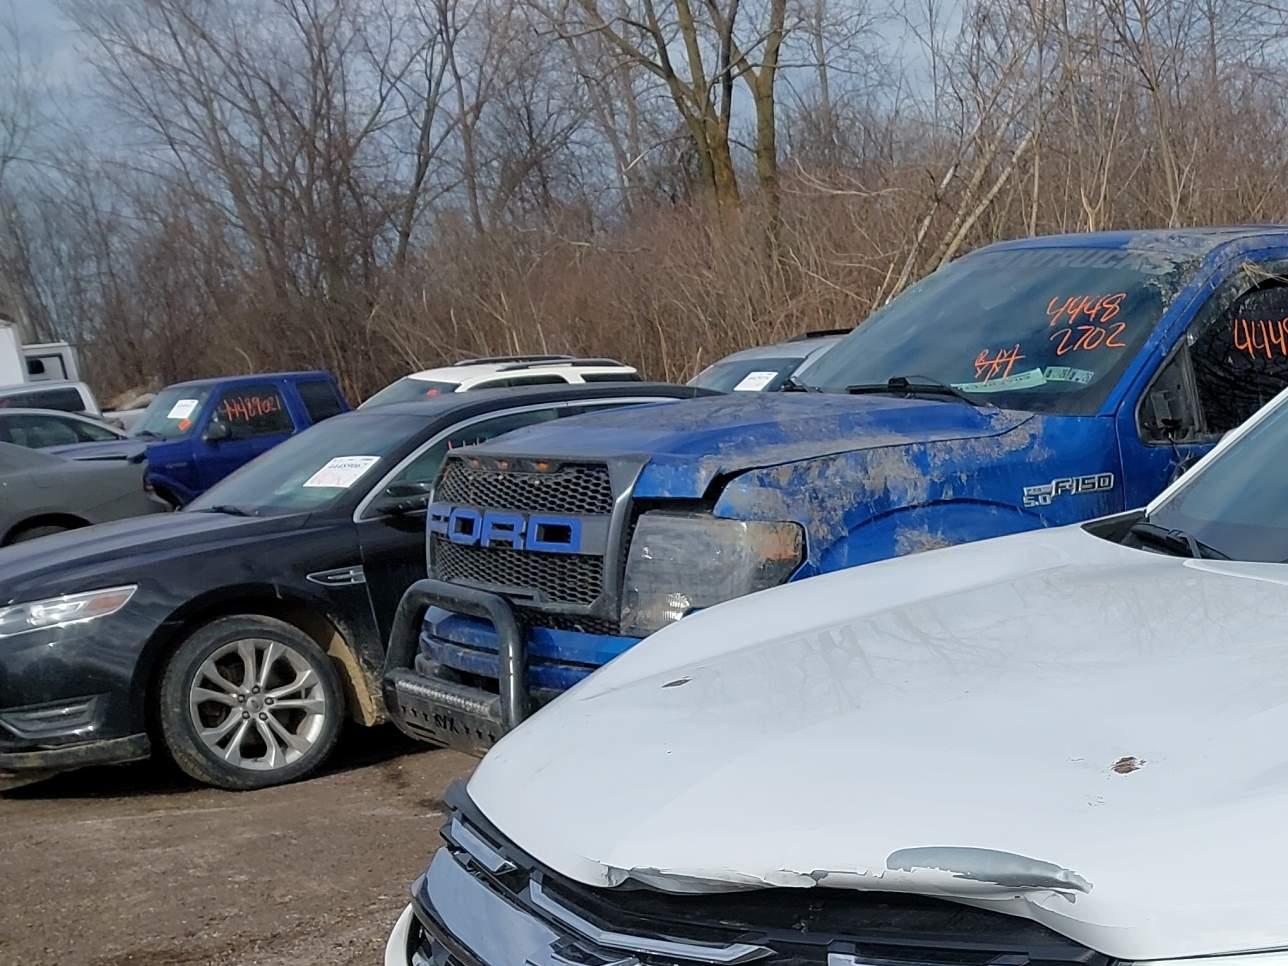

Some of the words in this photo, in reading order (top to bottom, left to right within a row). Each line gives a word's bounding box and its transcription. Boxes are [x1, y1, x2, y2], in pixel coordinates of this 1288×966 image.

[1046, 292, 1127, 327] 4448
[1049, 321, 1127, 356] 2702
[430, 501, 582, 553] FORD
